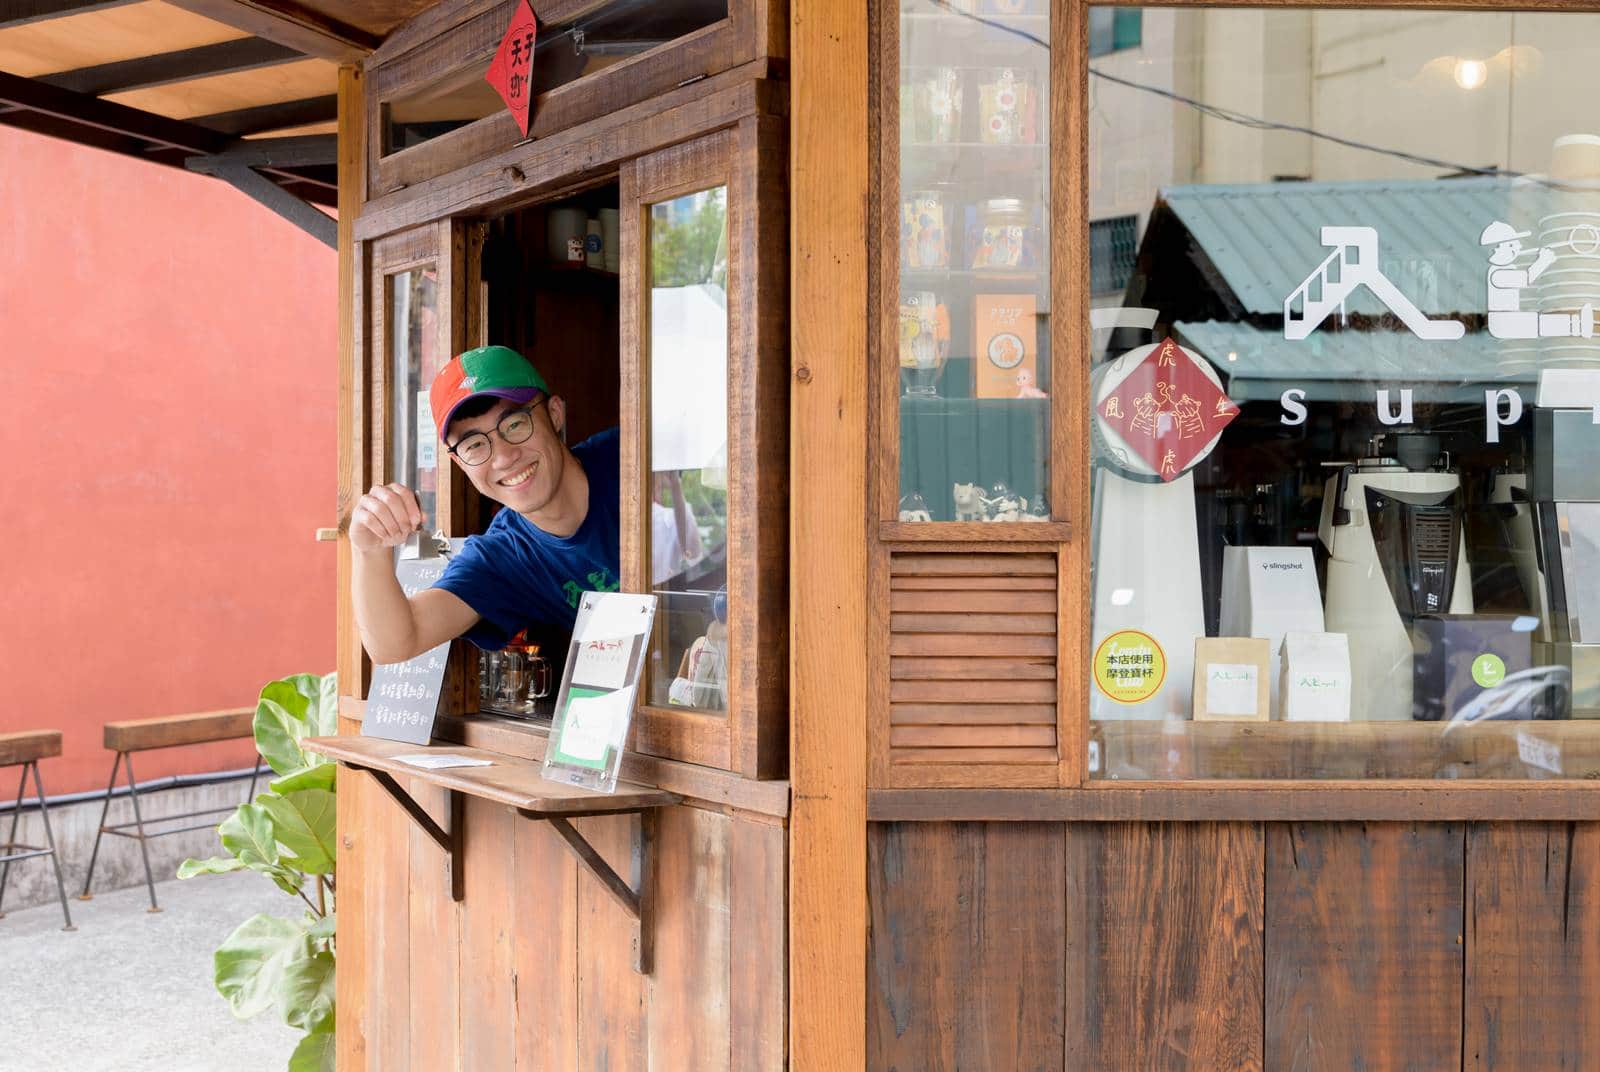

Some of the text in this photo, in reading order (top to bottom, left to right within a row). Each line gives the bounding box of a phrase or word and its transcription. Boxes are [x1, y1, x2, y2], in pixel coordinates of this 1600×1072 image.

[1158, 343, 1177, 367] 虎
[1105, 396, 1125, 419] 風
[1212, 396, 1235, 418] 生
[1161, 449, 1177, 474] 虎
[1269, 562, 1303, 571] slingshot
[1106, 654, 1154, 665] 本店使用
